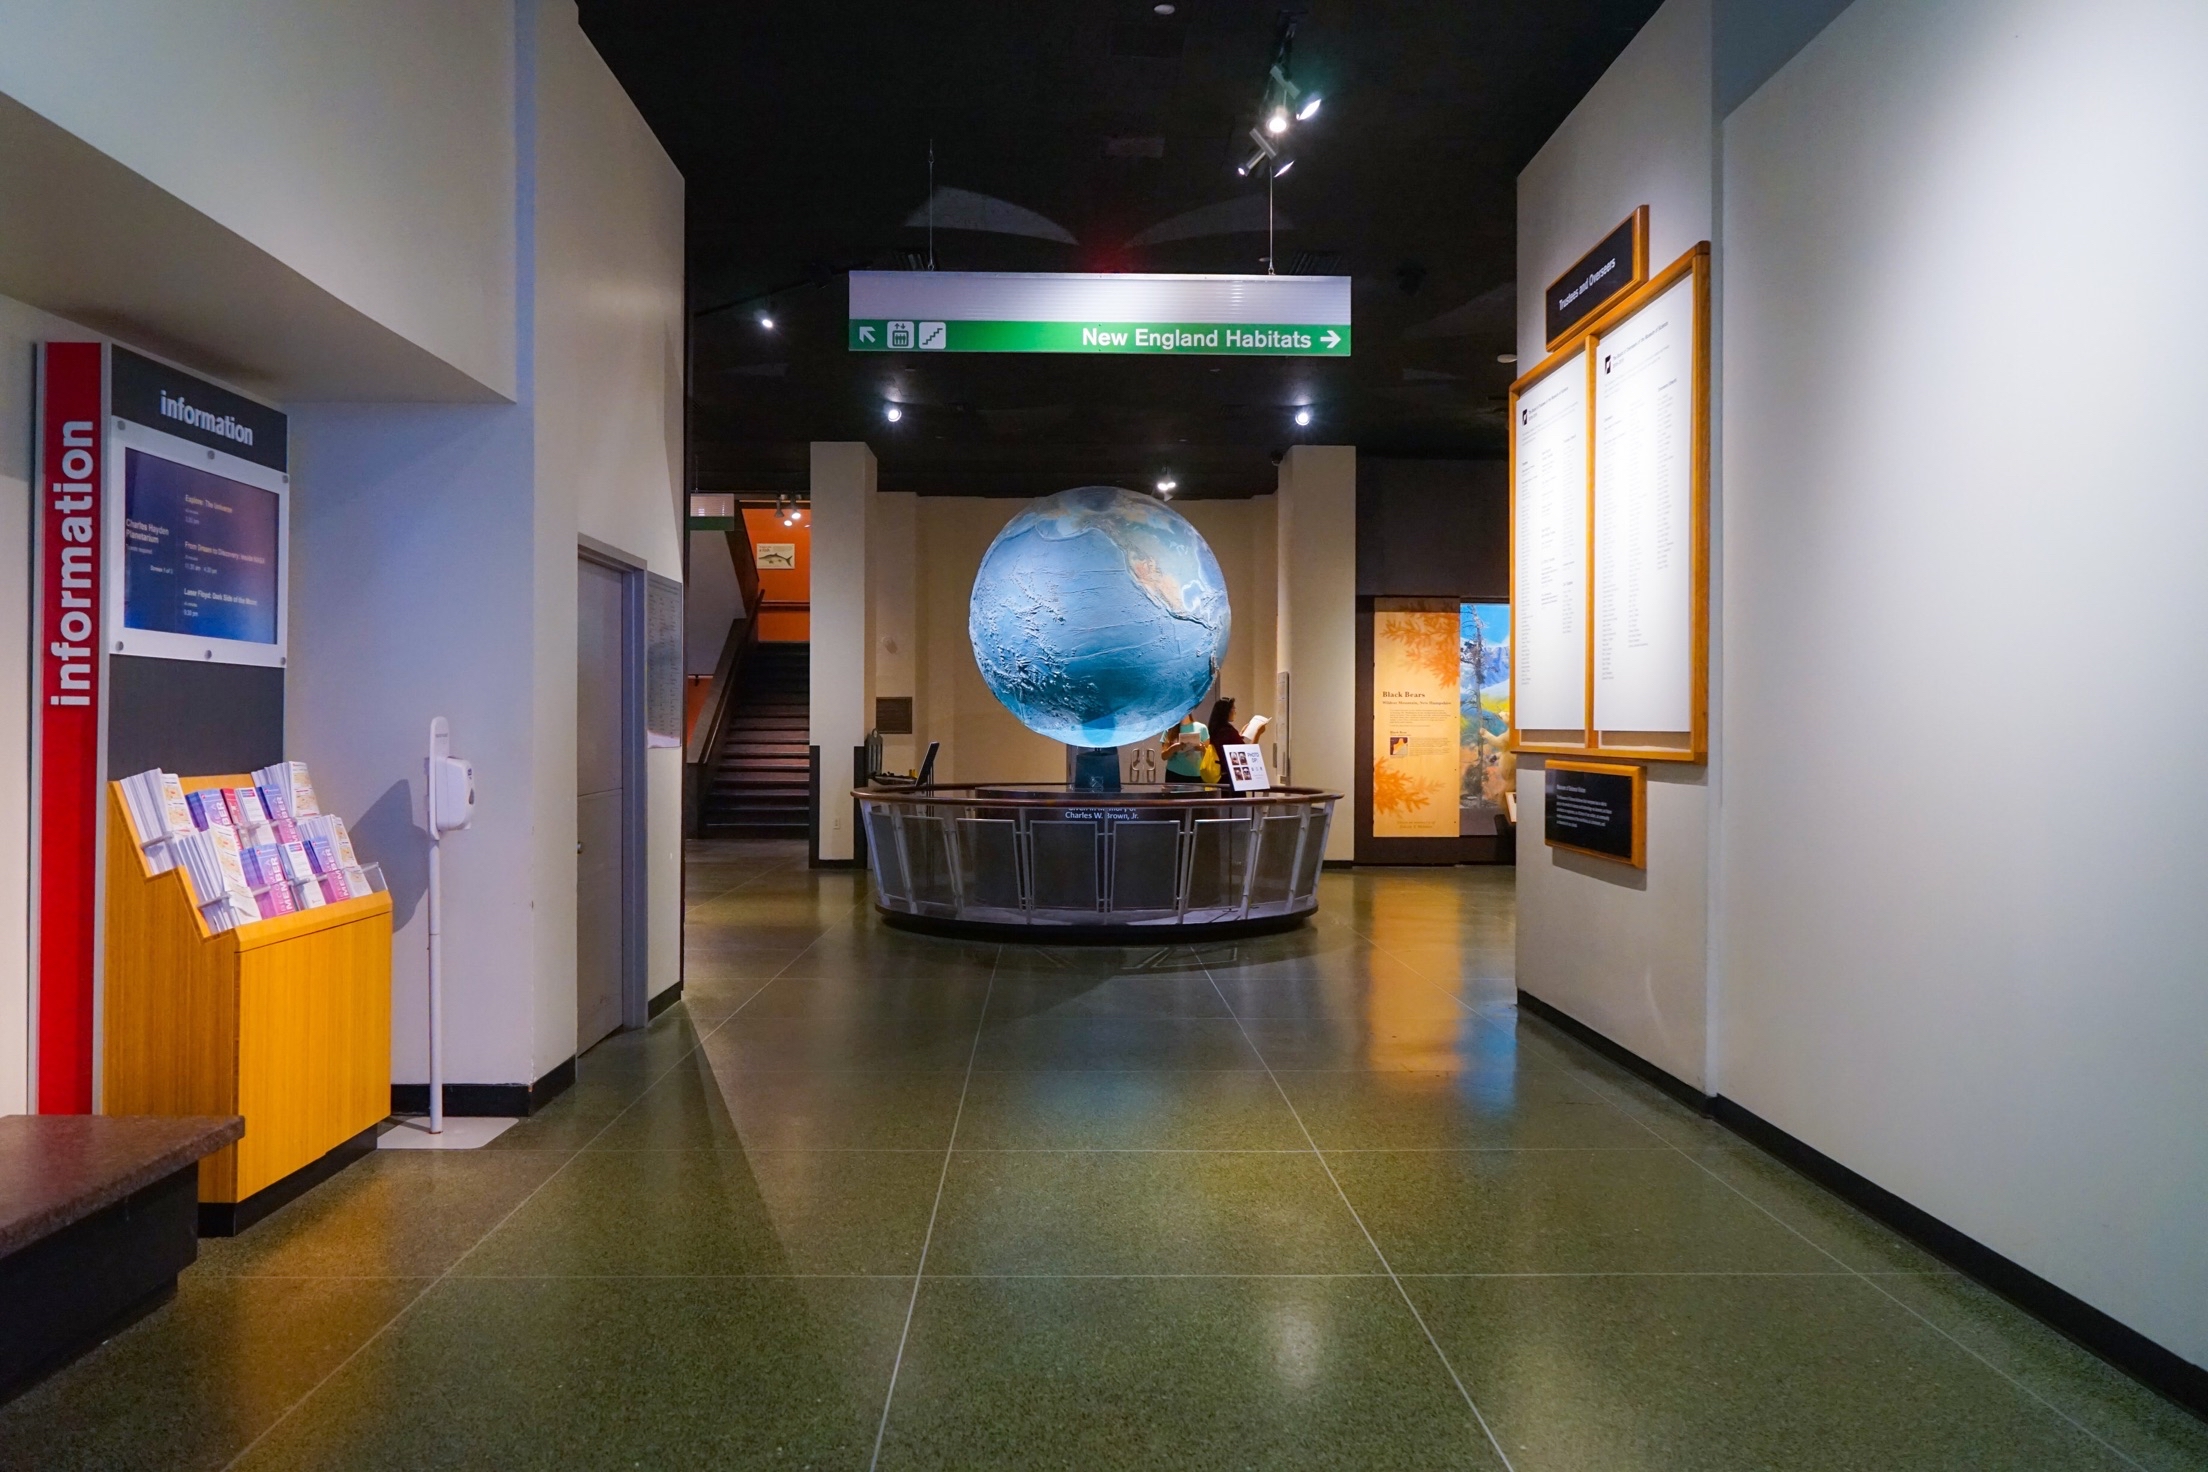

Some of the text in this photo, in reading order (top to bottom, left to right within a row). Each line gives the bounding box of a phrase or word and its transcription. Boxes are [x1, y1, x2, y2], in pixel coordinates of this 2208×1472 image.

[1559, 258, 1616, 311] Trustees and Overseers
[1082, 327, 1312, 350] New England Habitats
[160, 390, 253, 446] information
[126, 518, 169, 535] Charles Hayden
[126, 528, 159, 543] Planetarium
[50, 421, 94, 706] information
[1065, 811, 1092, 819] Charles
[270, 856, 292, 911] MEMBER
